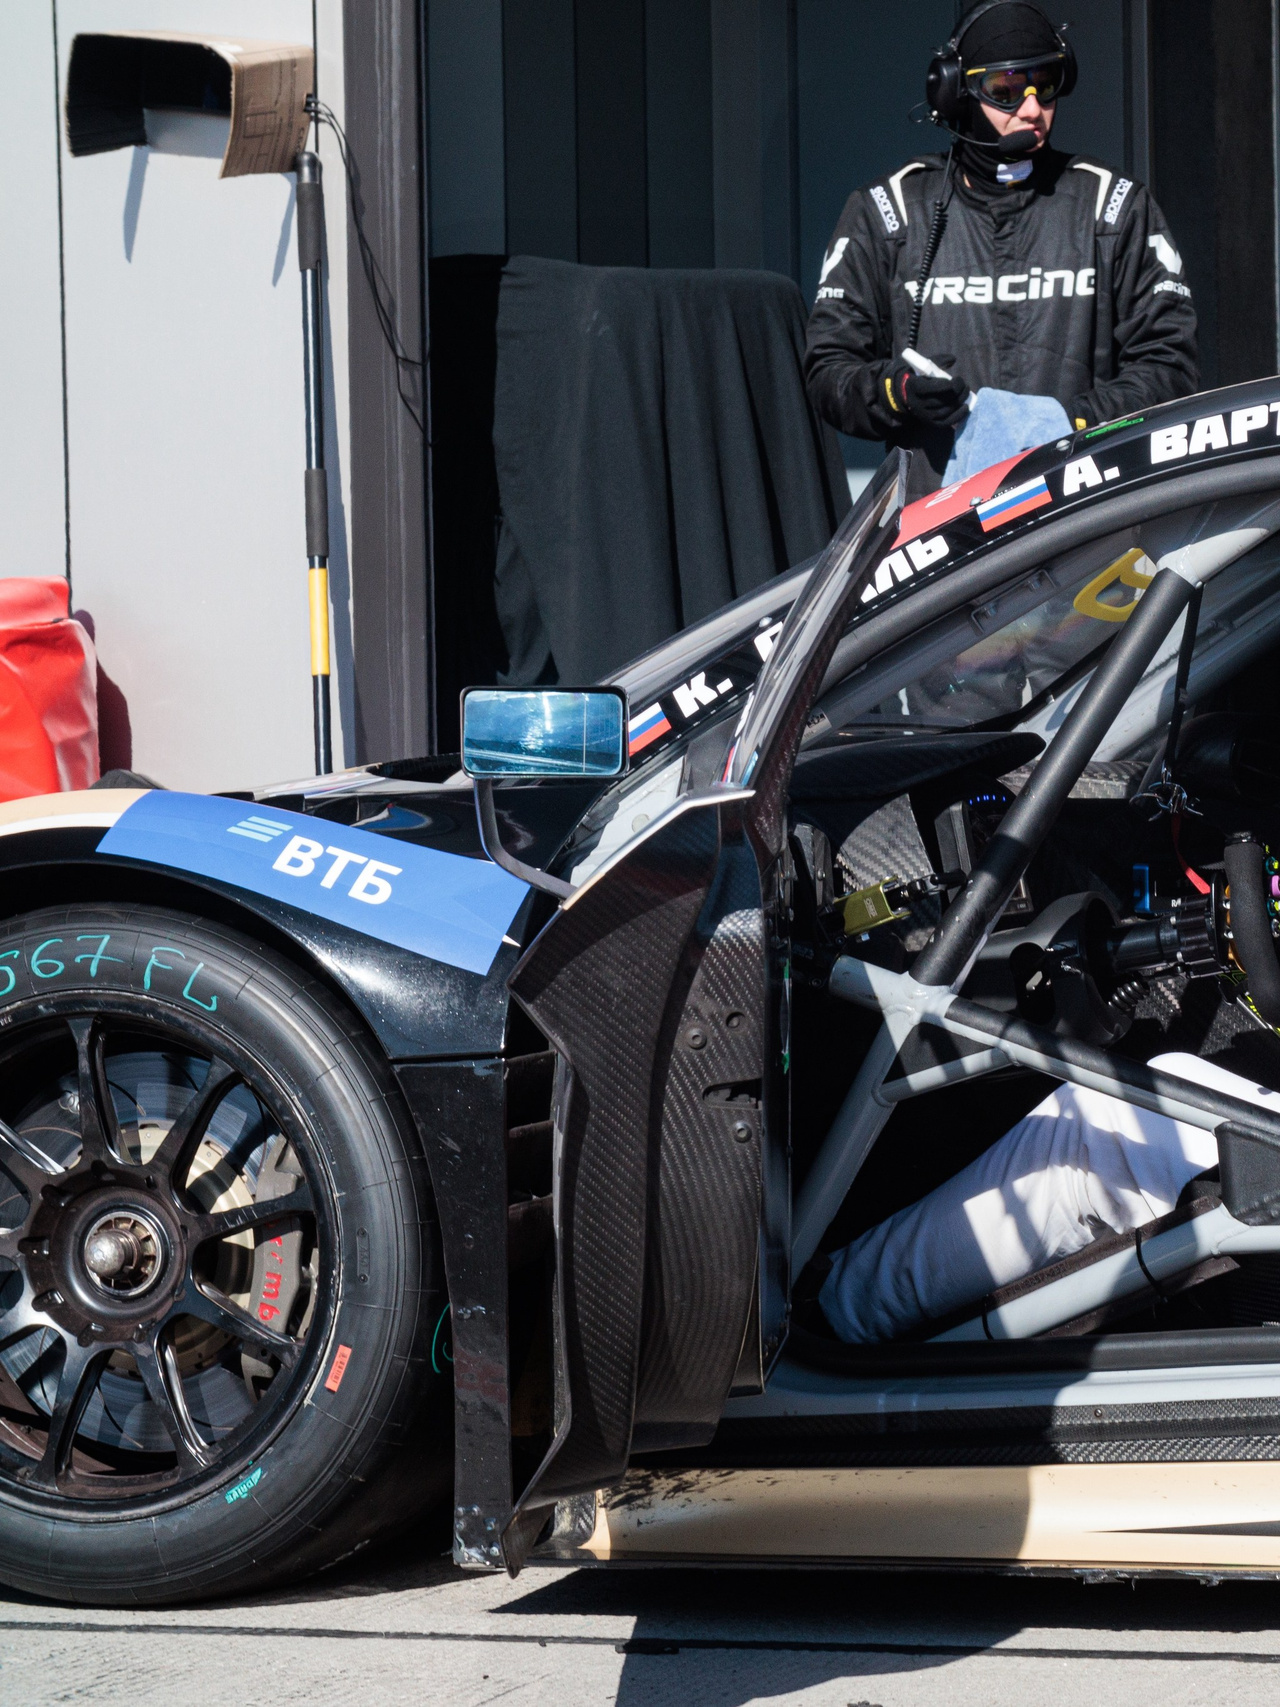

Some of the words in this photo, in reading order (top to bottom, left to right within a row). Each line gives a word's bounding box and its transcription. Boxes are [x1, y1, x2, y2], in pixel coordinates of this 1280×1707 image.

[869, 185, 900, 234] sparco
[1104, 177, 1134, 225] sparco
[1063, 454, 1120, 496] А.
[672, 671, 734, 719] К.
[272, 835, 403, 905] ВТБ
